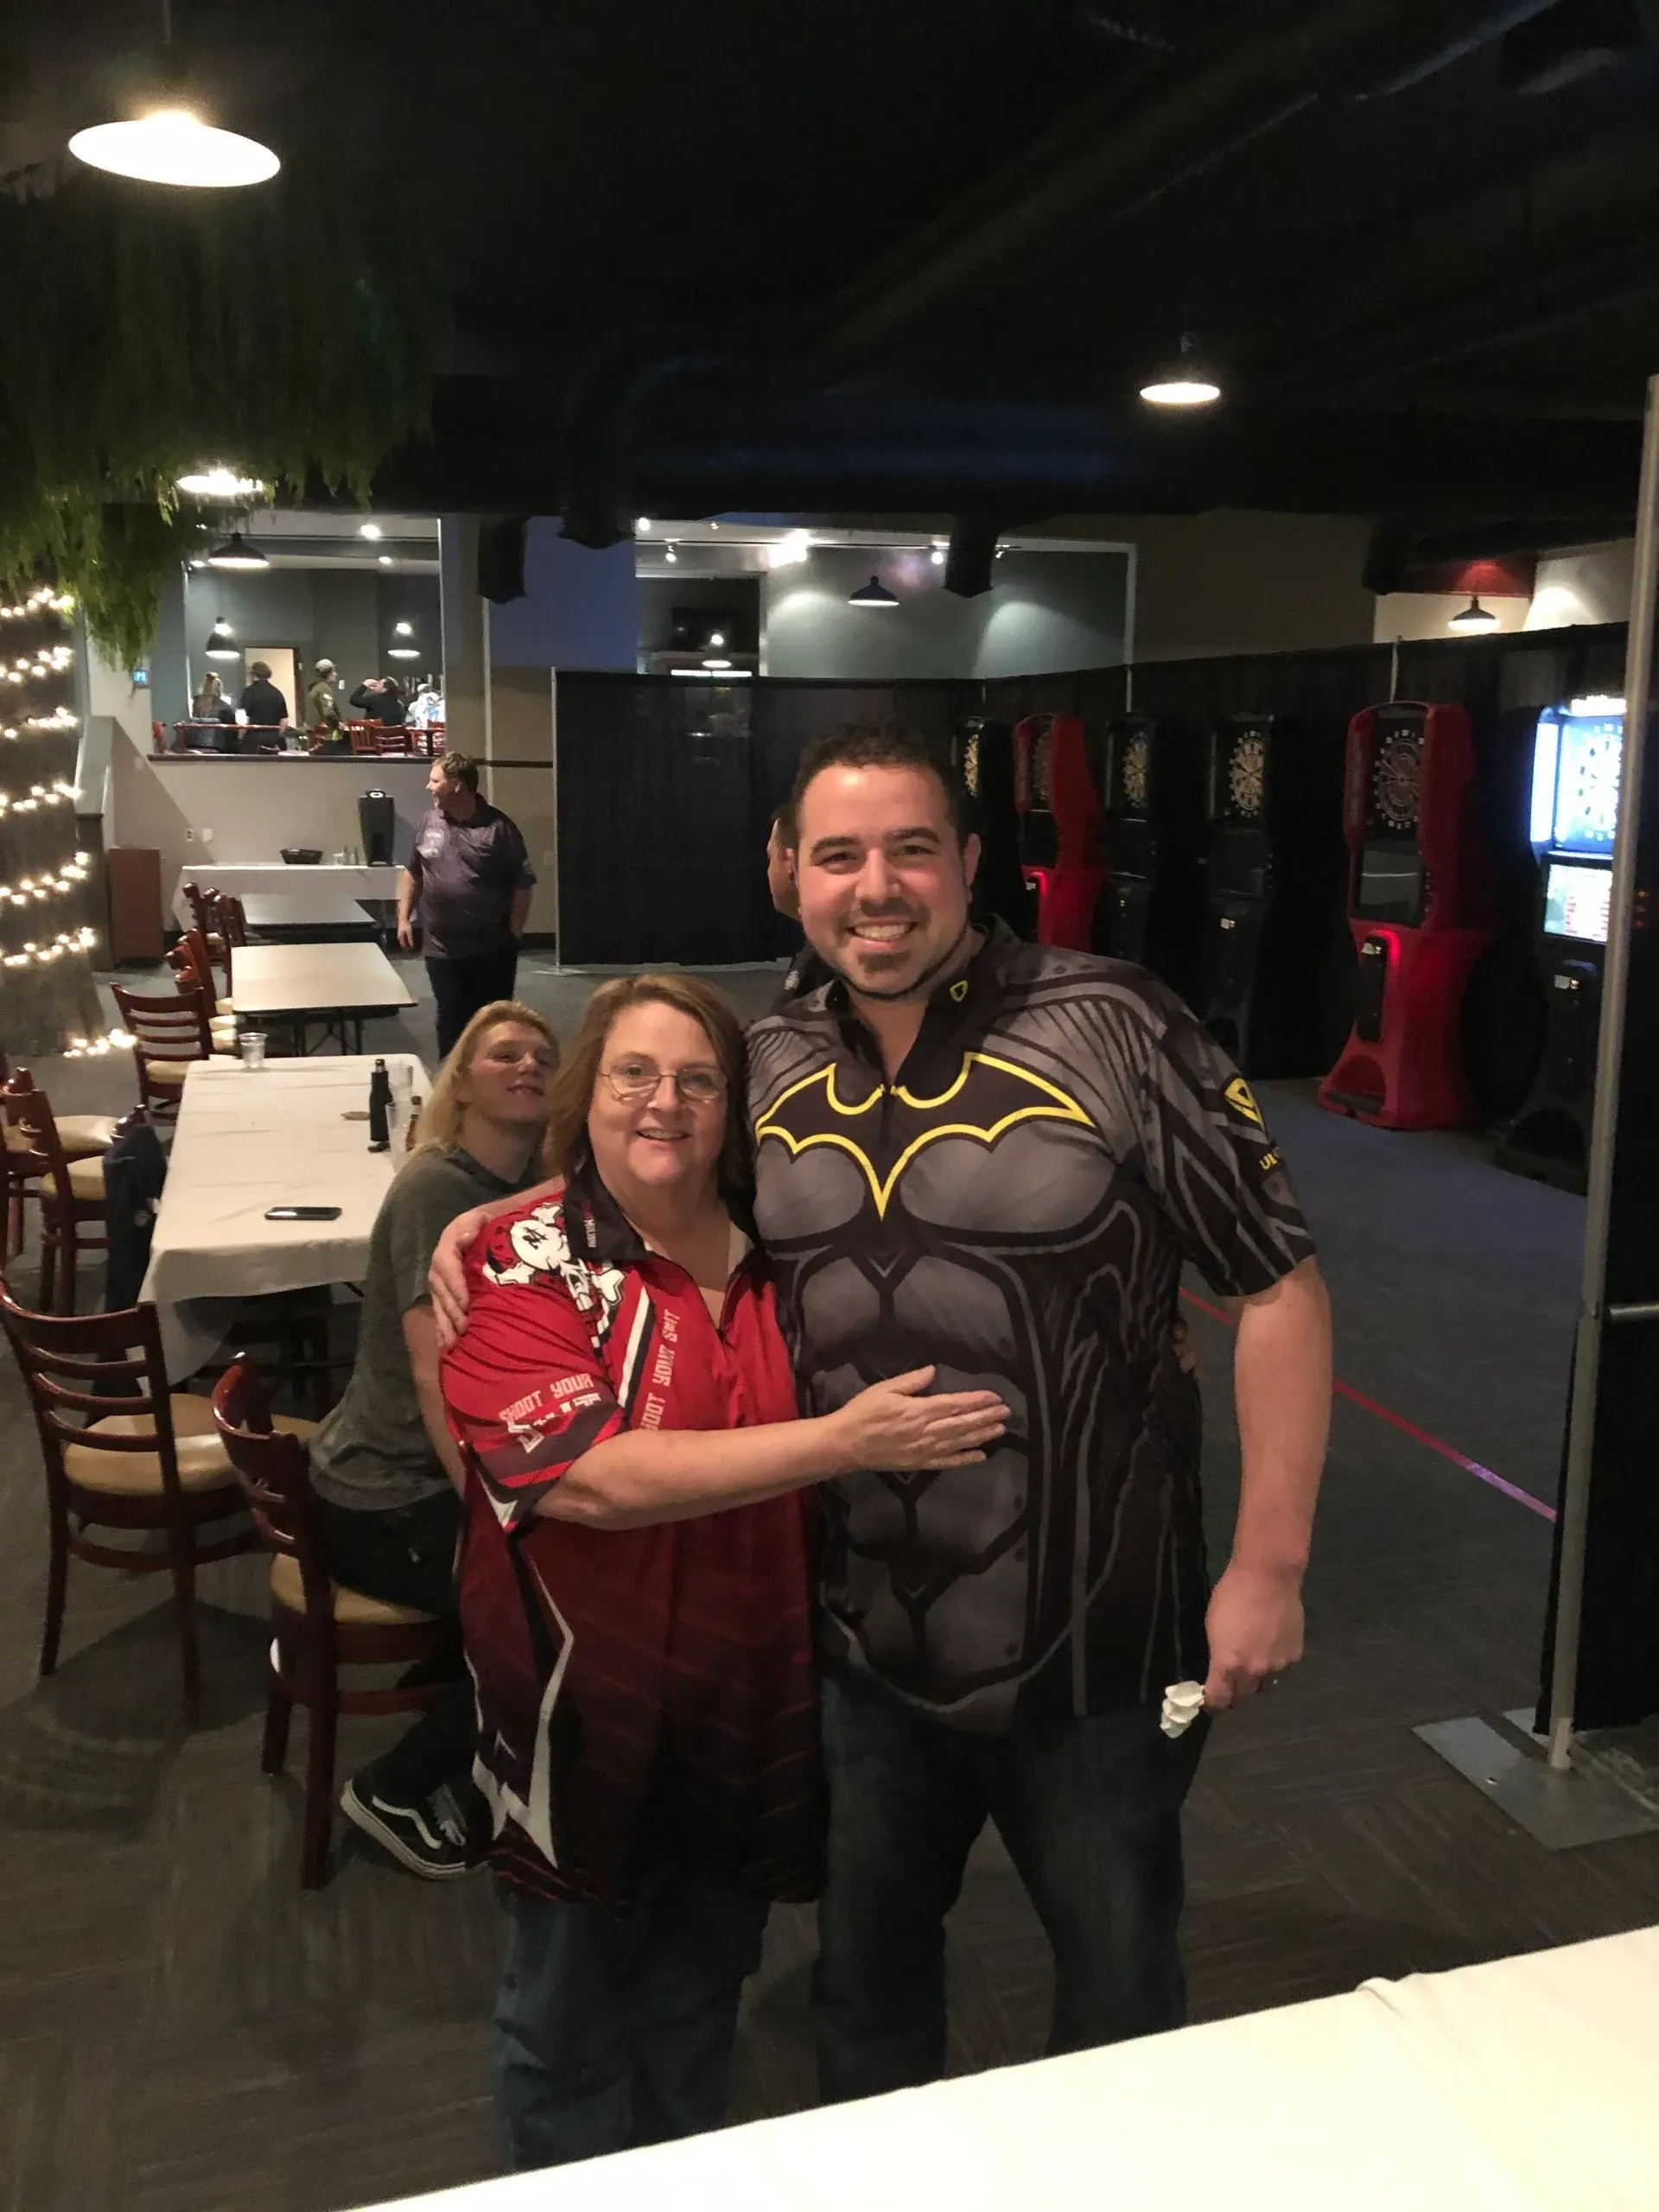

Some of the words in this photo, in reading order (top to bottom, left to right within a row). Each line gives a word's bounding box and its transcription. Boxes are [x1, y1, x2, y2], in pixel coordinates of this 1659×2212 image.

[652, 1344, 675, 1387] YOUR
[499, 1390, 544, 1422] SHOOT
[550, 1373, 595, 1399] YOUR
